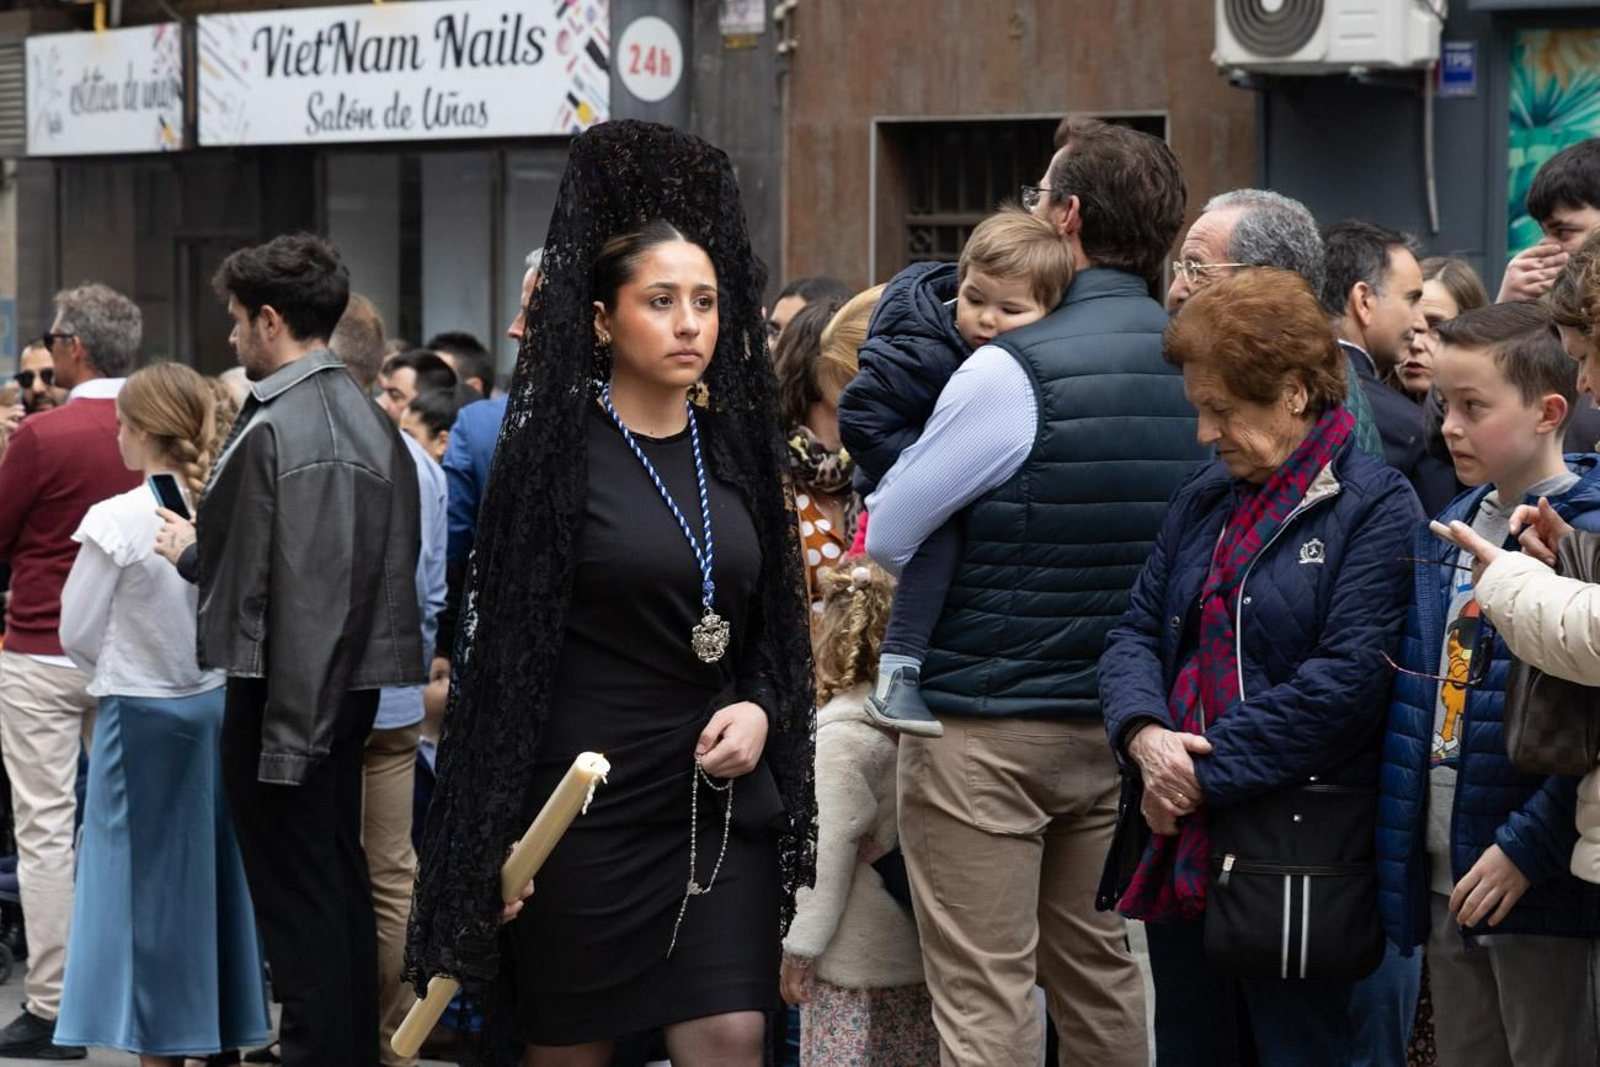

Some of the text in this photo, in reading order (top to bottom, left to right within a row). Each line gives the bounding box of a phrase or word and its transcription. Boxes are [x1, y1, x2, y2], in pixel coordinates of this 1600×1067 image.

[253, 13, 546, 77] VietNam Nails
[629, 43, 671, 77] 24h
[306, 86, 488, 136] Salón de Uñas
